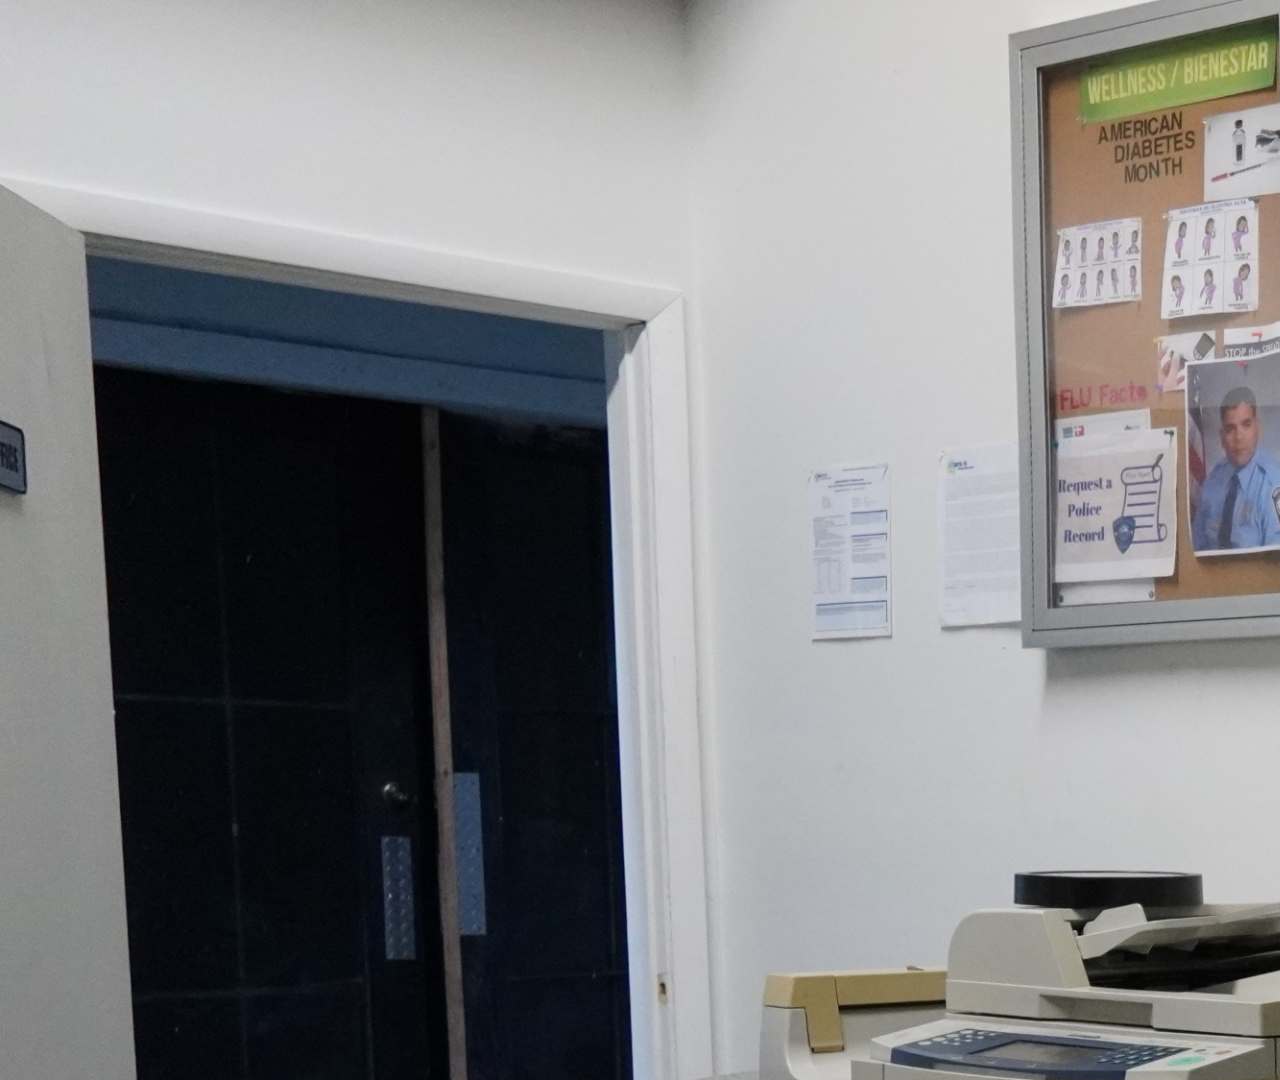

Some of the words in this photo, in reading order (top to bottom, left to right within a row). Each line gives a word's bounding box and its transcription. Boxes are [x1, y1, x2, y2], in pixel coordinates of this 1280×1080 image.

[1087, 63, 1167, 105] WELLNESS
[1183, 41, 1269, 84] BIENESTAR
[1098, 111, 1183, 145] AMERICAN
[1114, 131, 1195, 164] DIABETES
[1124, 157, 1183, 184] MONTH
[1058, 476, 1104, 496] Request
[1106, 479, 1113, 489] a
[1067, 503, 1102, 518] Police
[1063, 526, 1105, 544] Record
